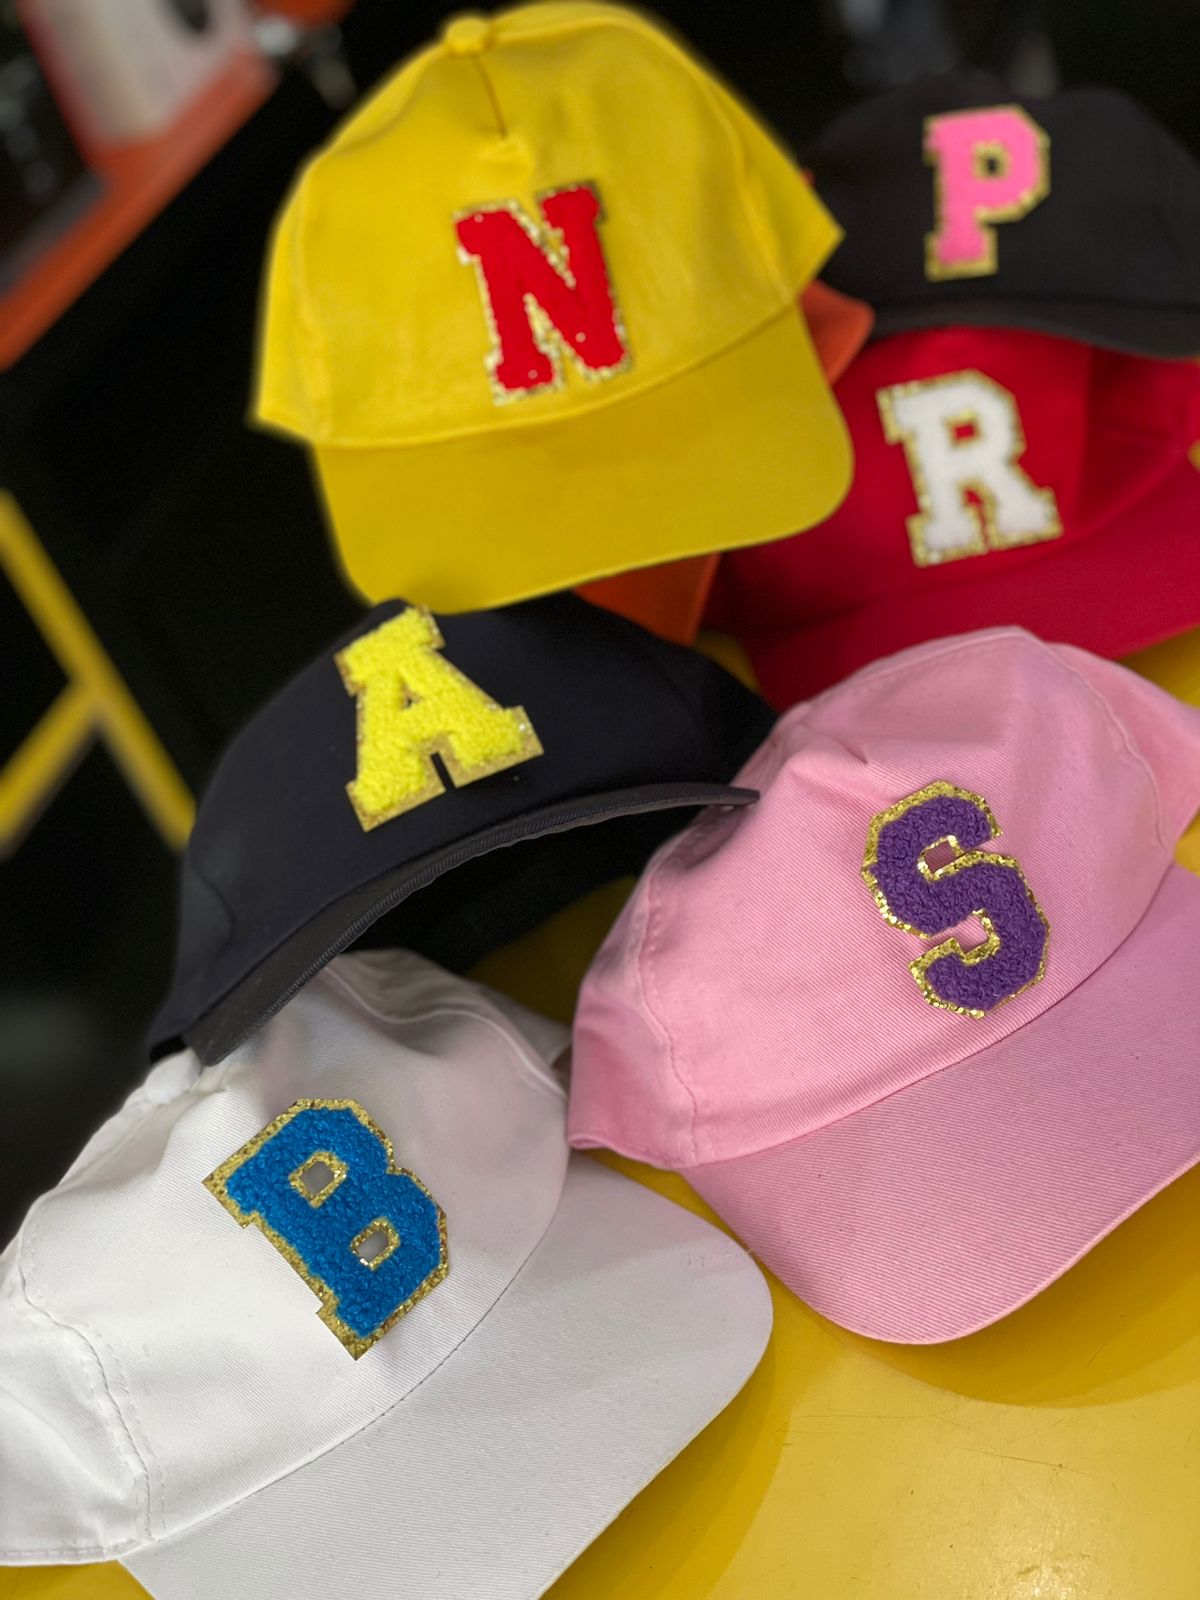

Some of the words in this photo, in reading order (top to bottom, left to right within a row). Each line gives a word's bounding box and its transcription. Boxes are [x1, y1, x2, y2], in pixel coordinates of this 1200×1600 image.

[452, 180, 634, 405] N
[924, 104, 1050, 282] P
[876, 369, 1063, 567] R
[333, 605, 544, 832] A
[861, 780, 1051, 1019] S
[202, 1098, 449, 1361] B
